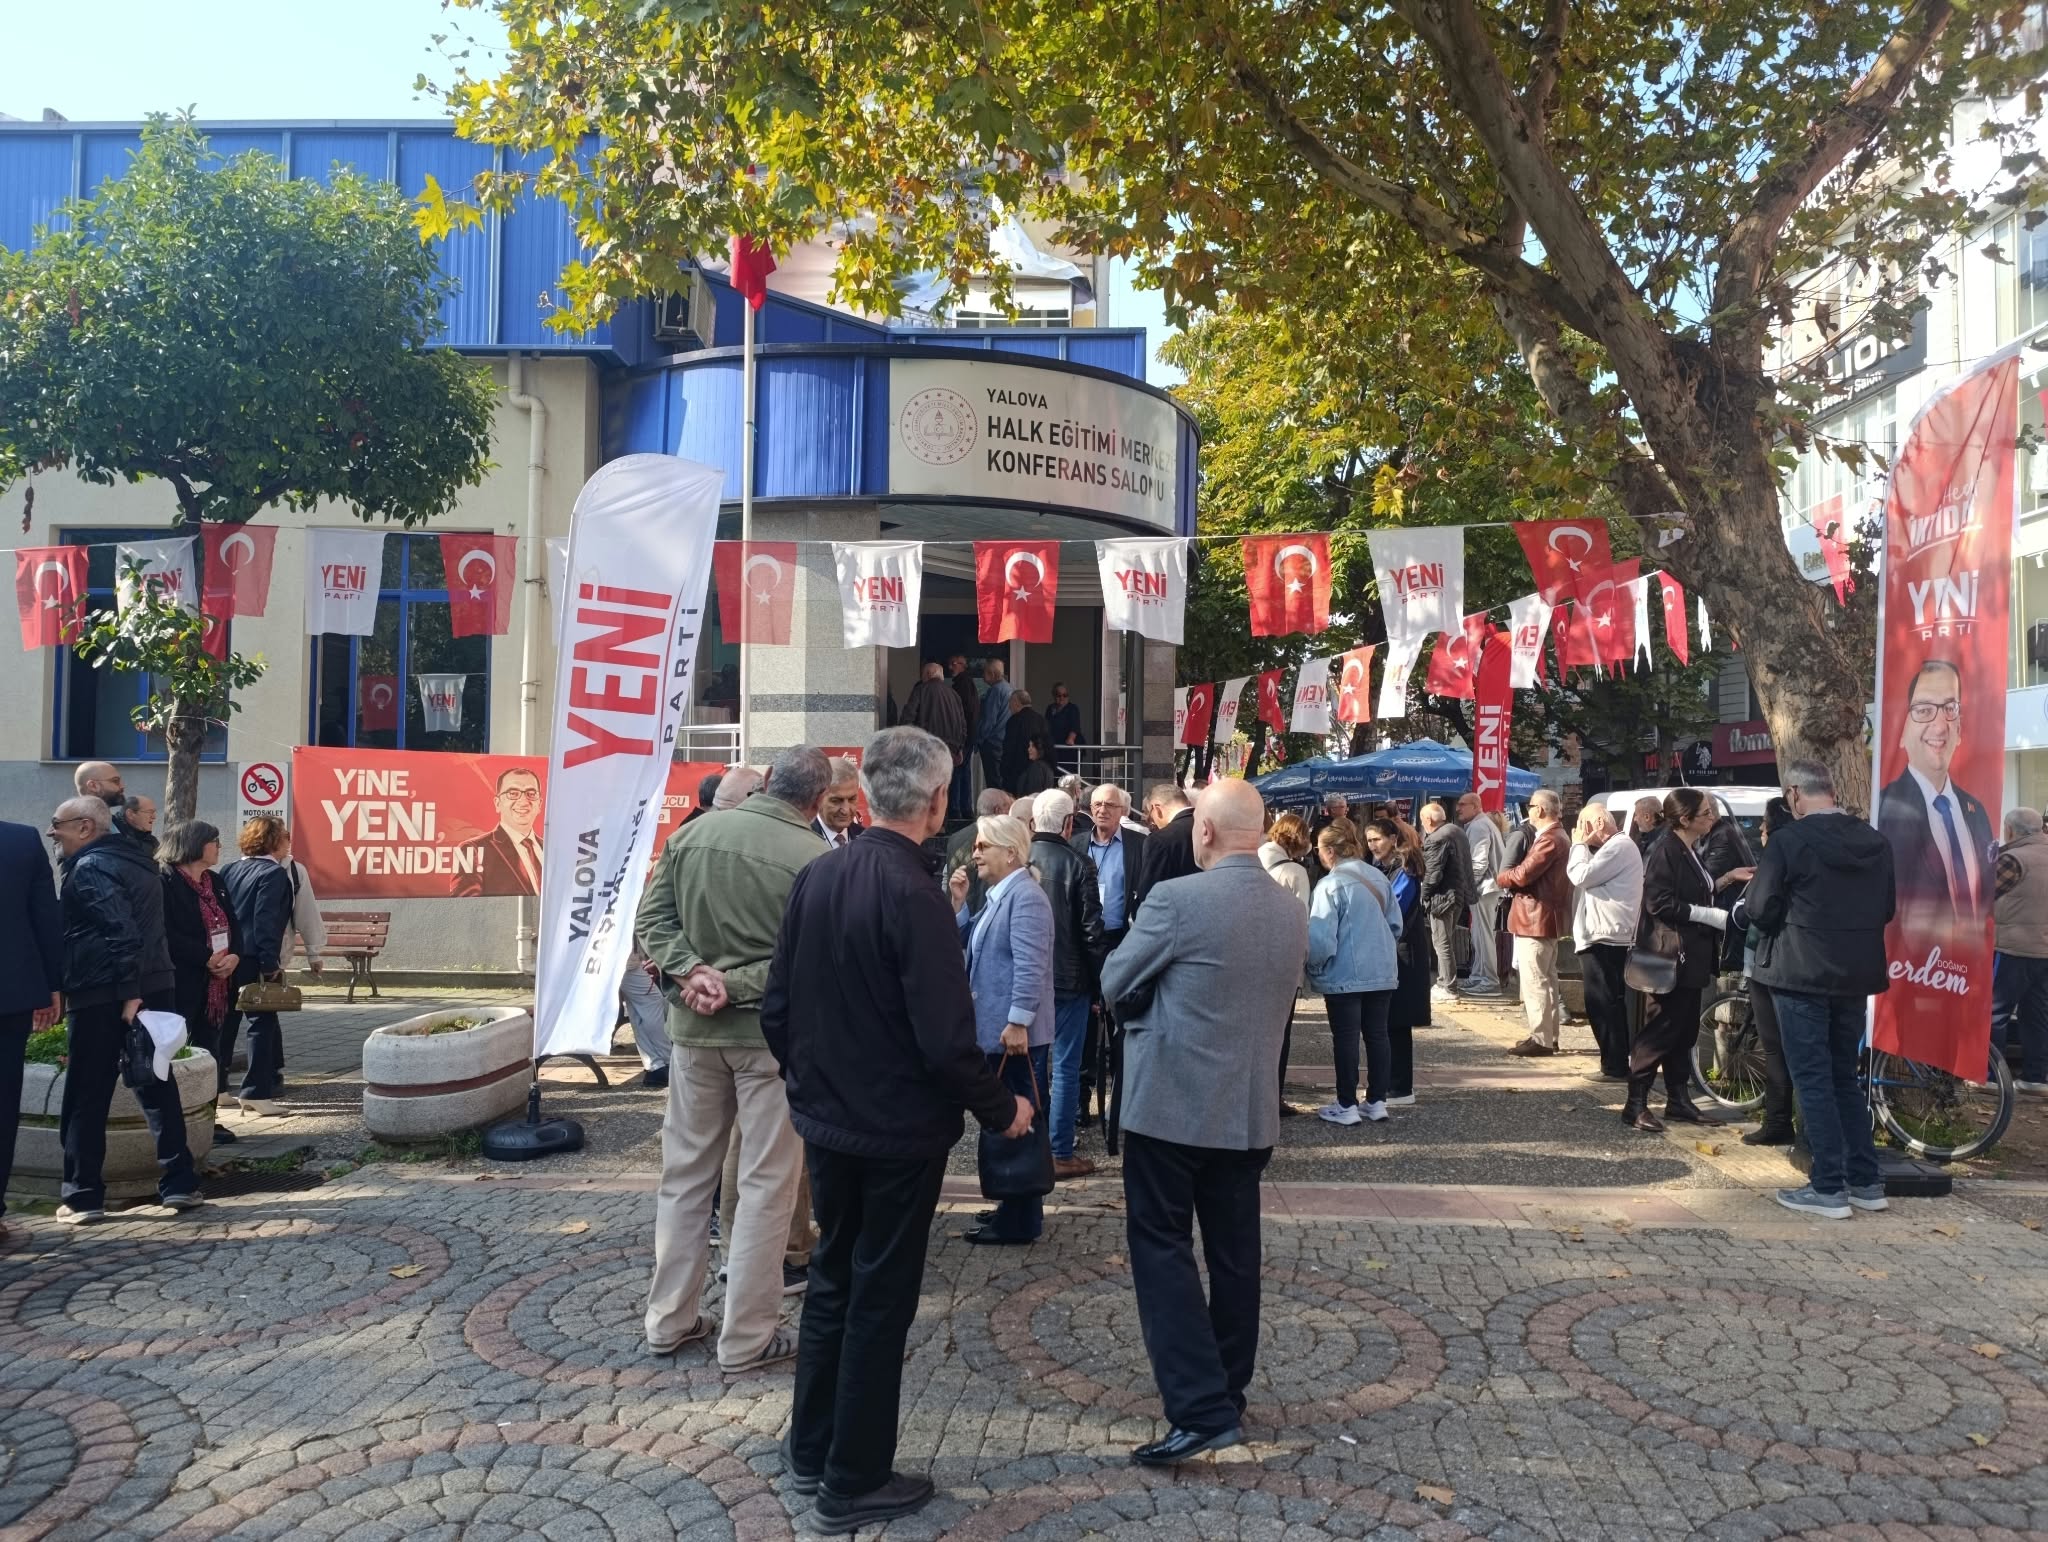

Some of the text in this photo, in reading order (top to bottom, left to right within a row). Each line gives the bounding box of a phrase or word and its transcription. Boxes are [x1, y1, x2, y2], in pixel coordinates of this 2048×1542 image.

[987, 388, 1048, 410] YALOVA
[988, 415, 1044, 444] HALK
[1050, 419, 1116, 456] EĞİTİMİ
[987, 449, 1164, 501] KONFERANS SALONU
[321, 564, 366, 591] YENİ
[854, 576, 904, 602] YENİ
[1114, 569, 1167, 598] YENİ
[1389, 563, 1444, 593] YENİ
[1921, 622, 1972, 641] PRTİ
[563, 583, 672, 769] YENİ
[664, 608, 698, 743] PARTİ
[1477, 705, 1502, 795] YENİ
[569, 828, 600, 943] YALOVA
[598, 871, 617, 897] İL
[1888, 945, 1970, 996] erdem
[1937, 958, 1968, 974] DOĞANCI
